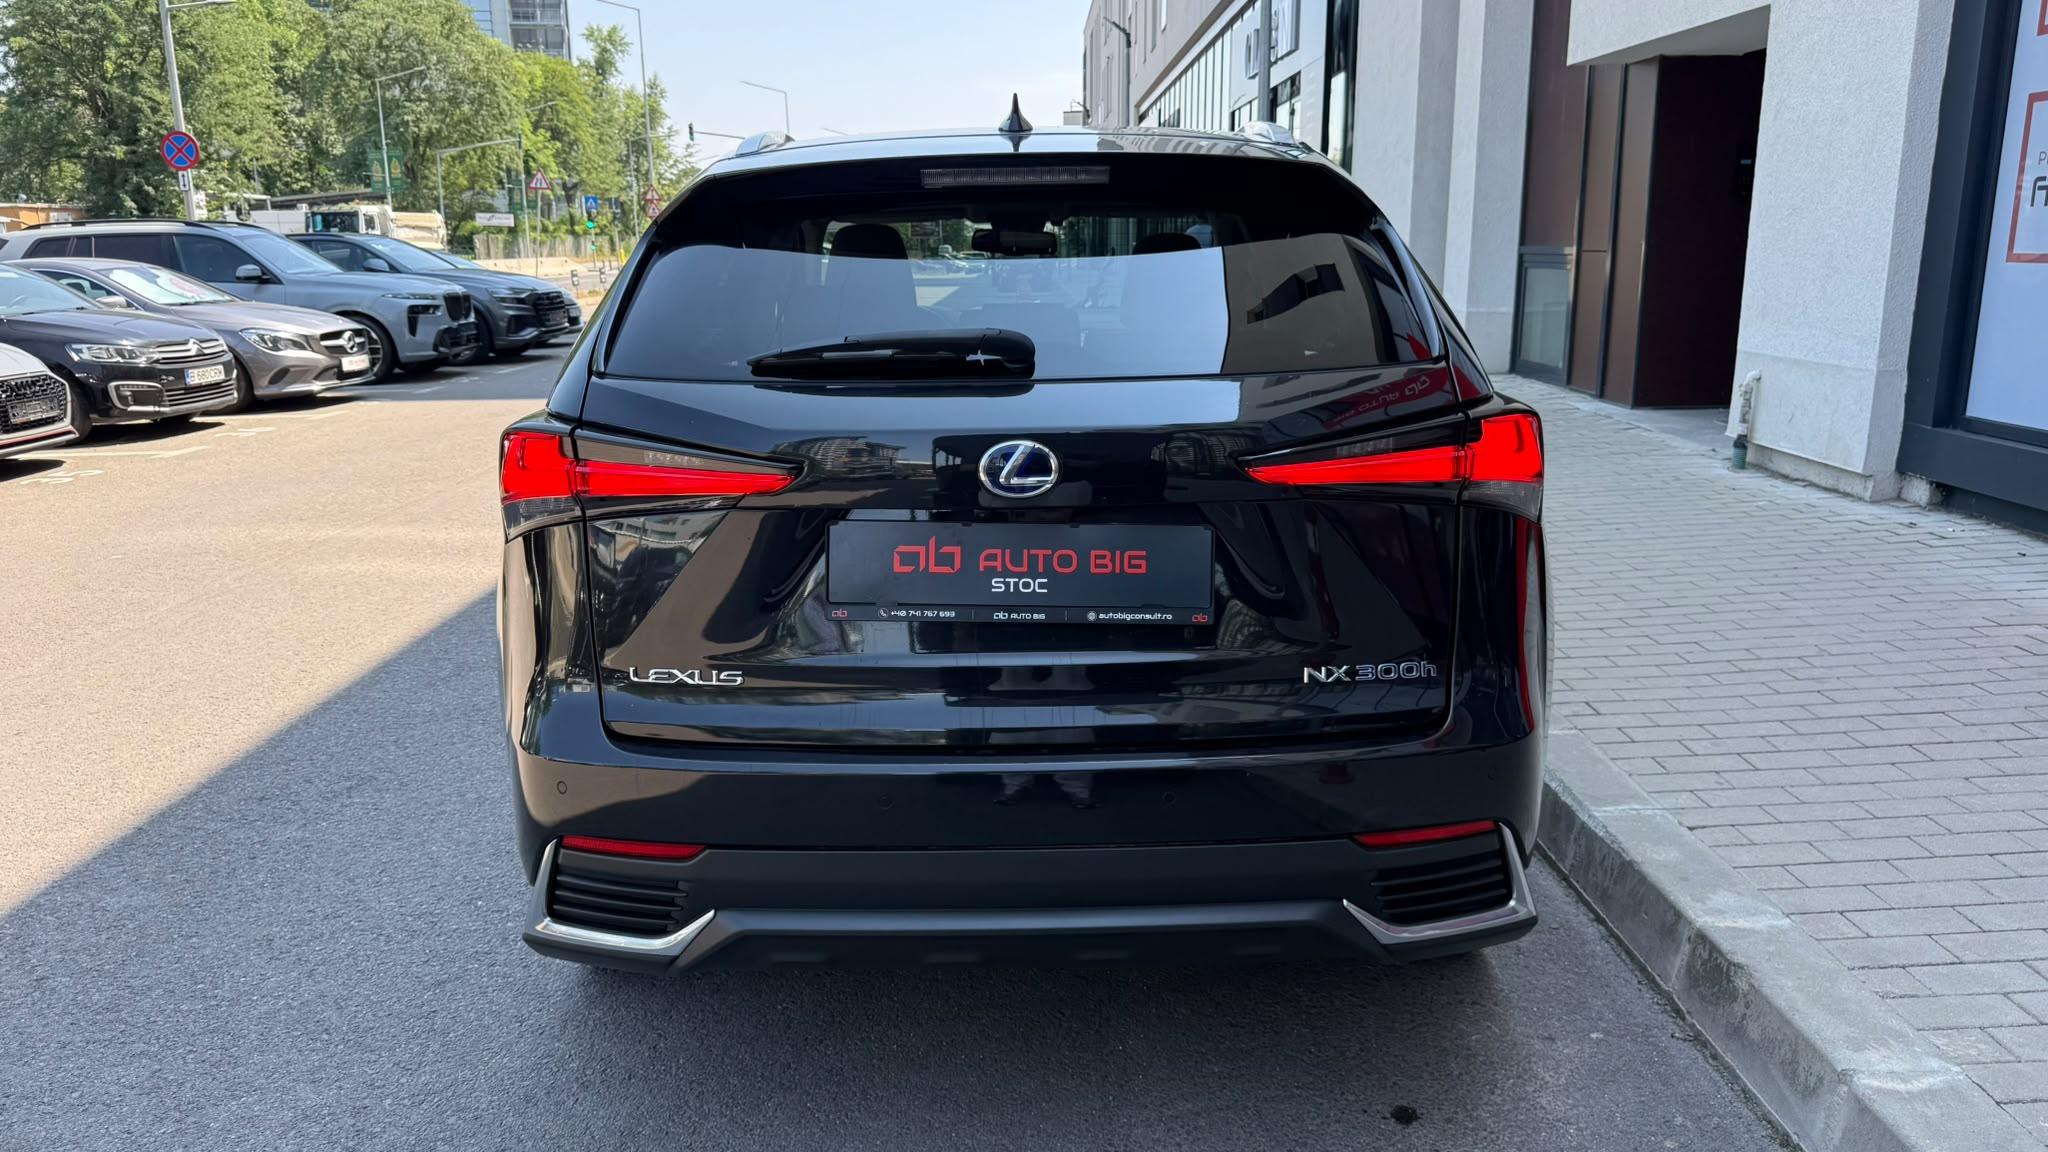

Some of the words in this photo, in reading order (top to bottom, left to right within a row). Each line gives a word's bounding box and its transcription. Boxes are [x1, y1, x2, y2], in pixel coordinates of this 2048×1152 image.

[979, 548, 1078, 573] AUTO
[1090, 550, 1147, 574] BIG
[991, 578, 1048, 593] STOC
[1098, 612, 1173, 621] autobigconsult.ro
[629, 667, 743, 686] LEXUS
[1303, 665, 1352, 683] NX
[1355, 661, 1437, 681] 300h
